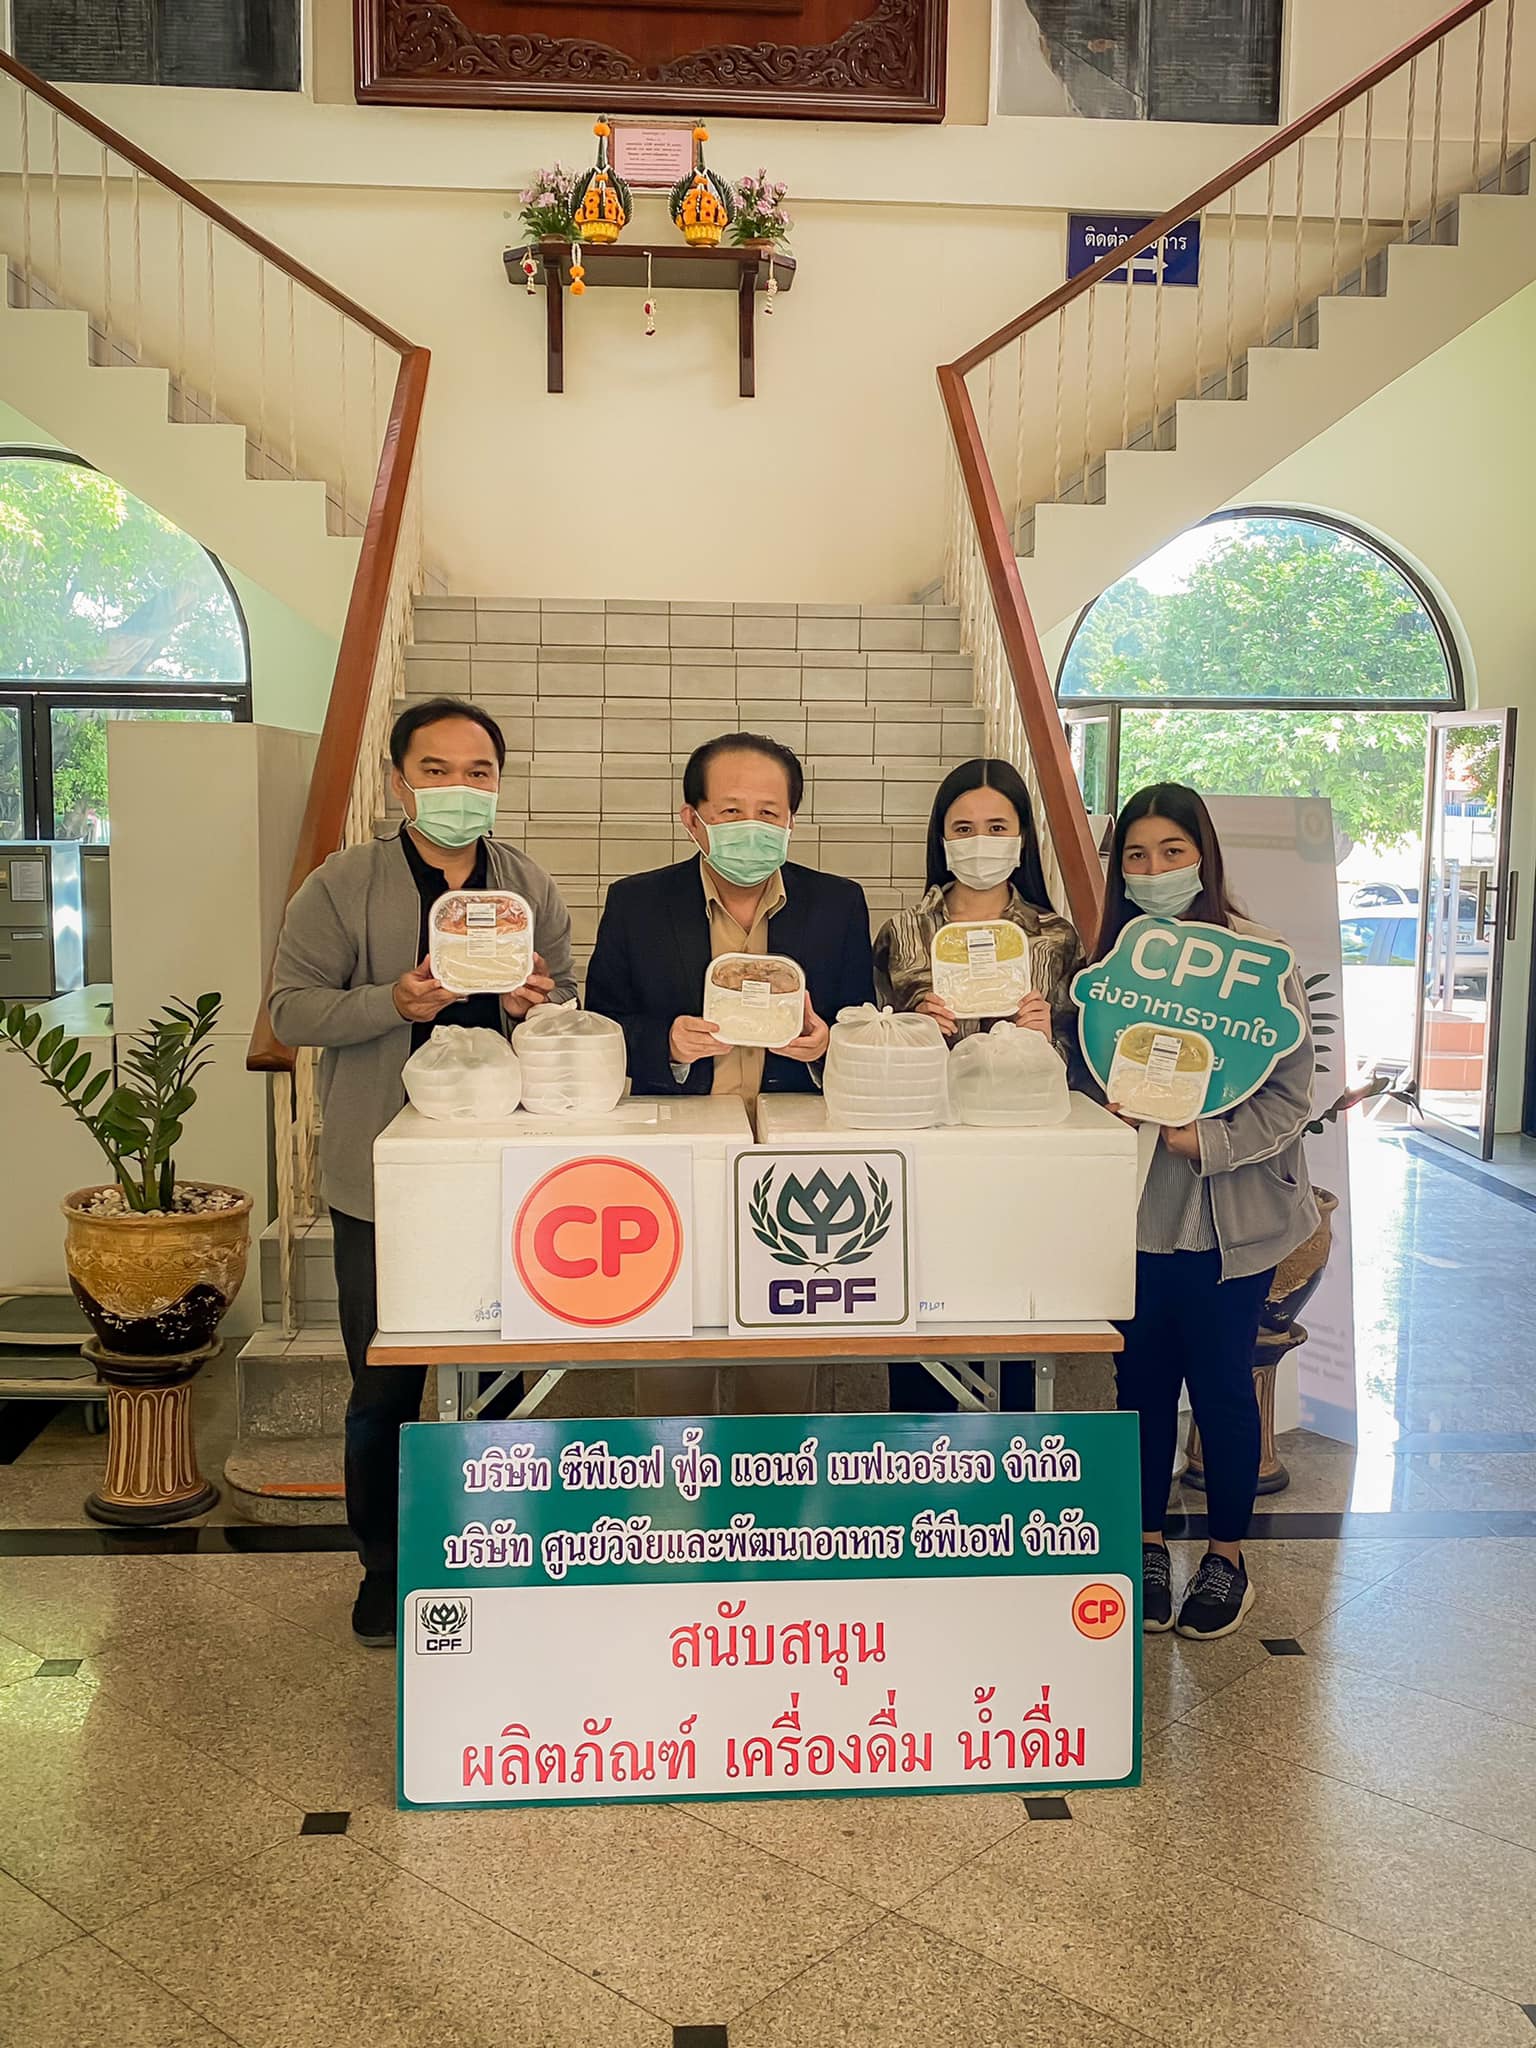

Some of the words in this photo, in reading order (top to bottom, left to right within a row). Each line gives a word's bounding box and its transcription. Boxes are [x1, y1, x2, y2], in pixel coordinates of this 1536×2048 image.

[1130, 928, 1272, 1000] CPF
[1088, 976, 1279, 1048] ส่งอาหารจากใจ
[533, 1204, 660, 1278] CP
[768, 1277, 878, 1315] CPF
[466, 1445, 549, 1490] บริษัท
[561, 1444, 662, 1488] ซีพีเอฟ
[674, 1430, 719, 1498] ฟู้ด
[734, 1441, 816, 1484] แอนด์
[829, 1438, 993, 1483] เบฟเวอร์เรจ
[1004, 1437, 1078, 1480] จำกัด
[447, 1521, 530, 1566] บริษัท
[544, 1516, 904, 1577] ศูนย์วิจัยและพัฒนาอาหาร
[913, 1512, 1011, 1555] ซีพีเอฟ
[1023, 1510, 1097, 1553] จำกัด
[426, 1638, 463, 1651] CPF
[671, 1600, 886, 1686] สนับสนุน
[1077, 1599, 1119, 1625] CP
[463, 1714, 698, 1787] ผลิตภัณฑ์
[726, 1689, 933, 1778] เครื่องดื่ม
[958, 1685, 1086, 1771] น้ำดื่ม
